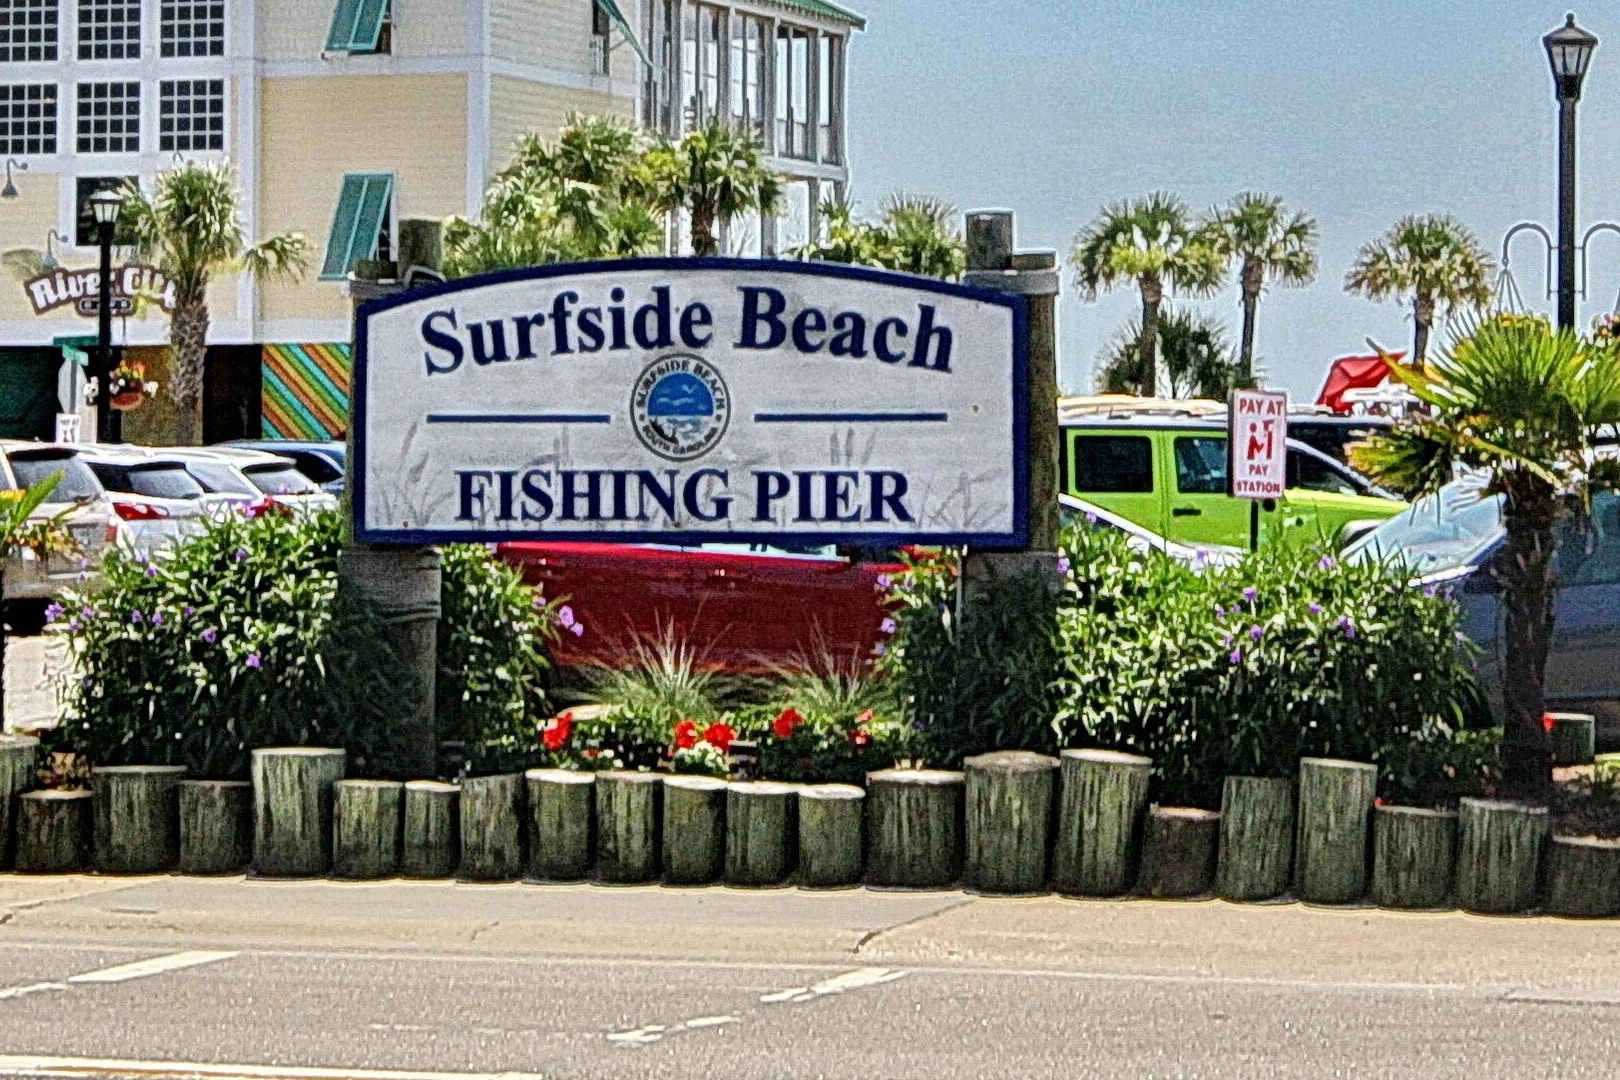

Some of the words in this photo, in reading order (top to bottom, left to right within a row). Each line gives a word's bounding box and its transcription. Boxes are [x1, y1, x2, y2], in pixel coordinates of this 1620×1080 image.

[422, 286, 714, 376] Surfside
[735, 286, 953, 372] Beach
[636, 359, 690, 408] SURFSIDE
[694, 363, 726, 410] BEACH
[1239, 398, 1264, 414] PAY
[1267, 399, 1284, 415] AT
[1237, 480, 1281, 493] STATION
[1249, 464, 1268, 476] PAY
[455, 468, 733, 523] FISHING
[753, 470, 915, 523] PIER
